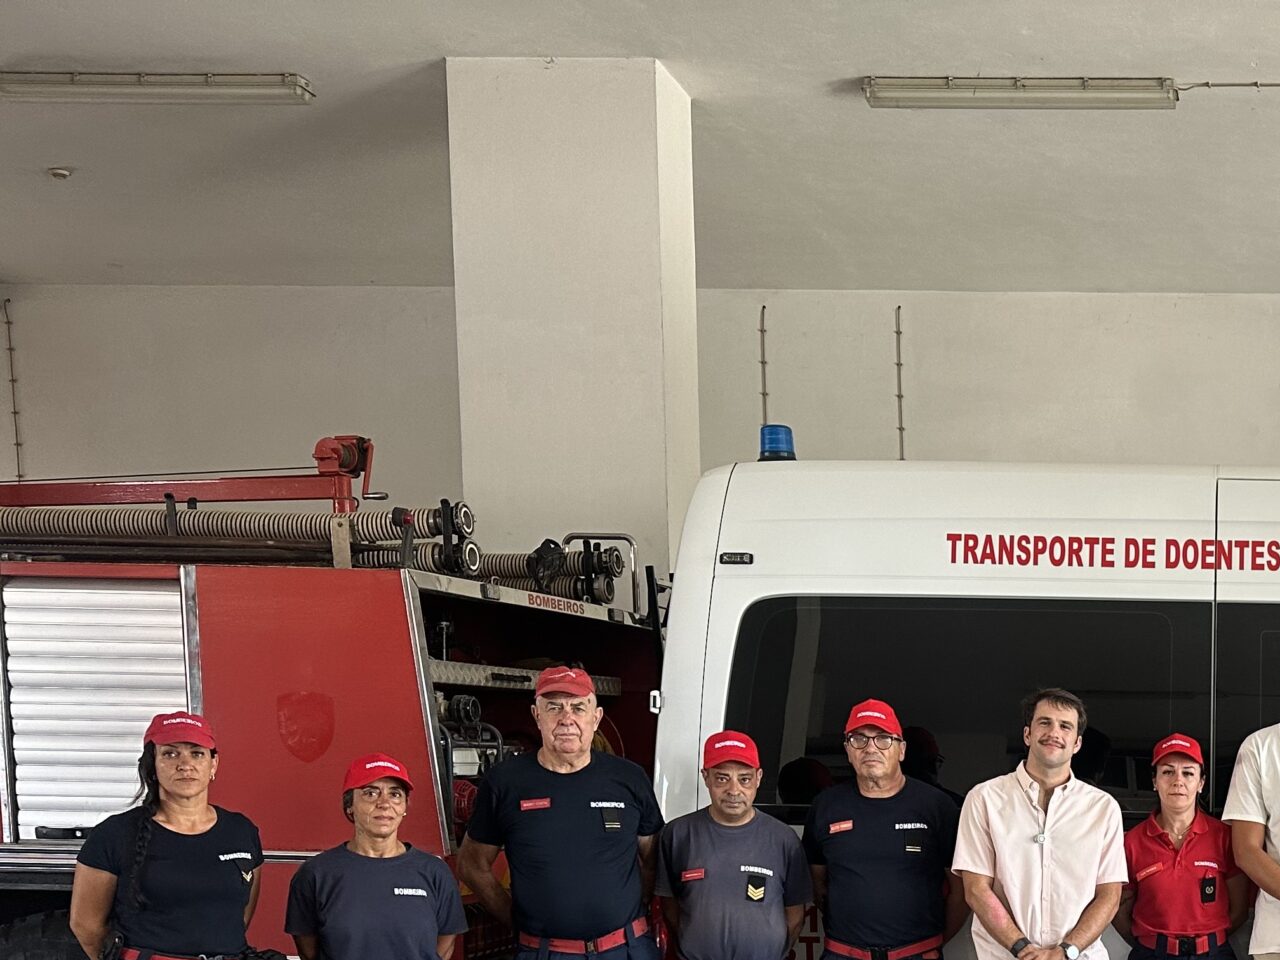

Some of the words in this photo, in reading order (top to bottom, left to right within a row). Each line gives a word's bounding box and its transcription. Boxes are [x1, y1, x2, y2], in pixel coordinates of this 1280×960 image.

[947, 533, 1115, 568] TRANSPORTE
[1124, 537, 1156, 569] DE
[1165, 538, 1280, 571] DOENTES
[527, 593, 585, 615] BOMBEIROS
